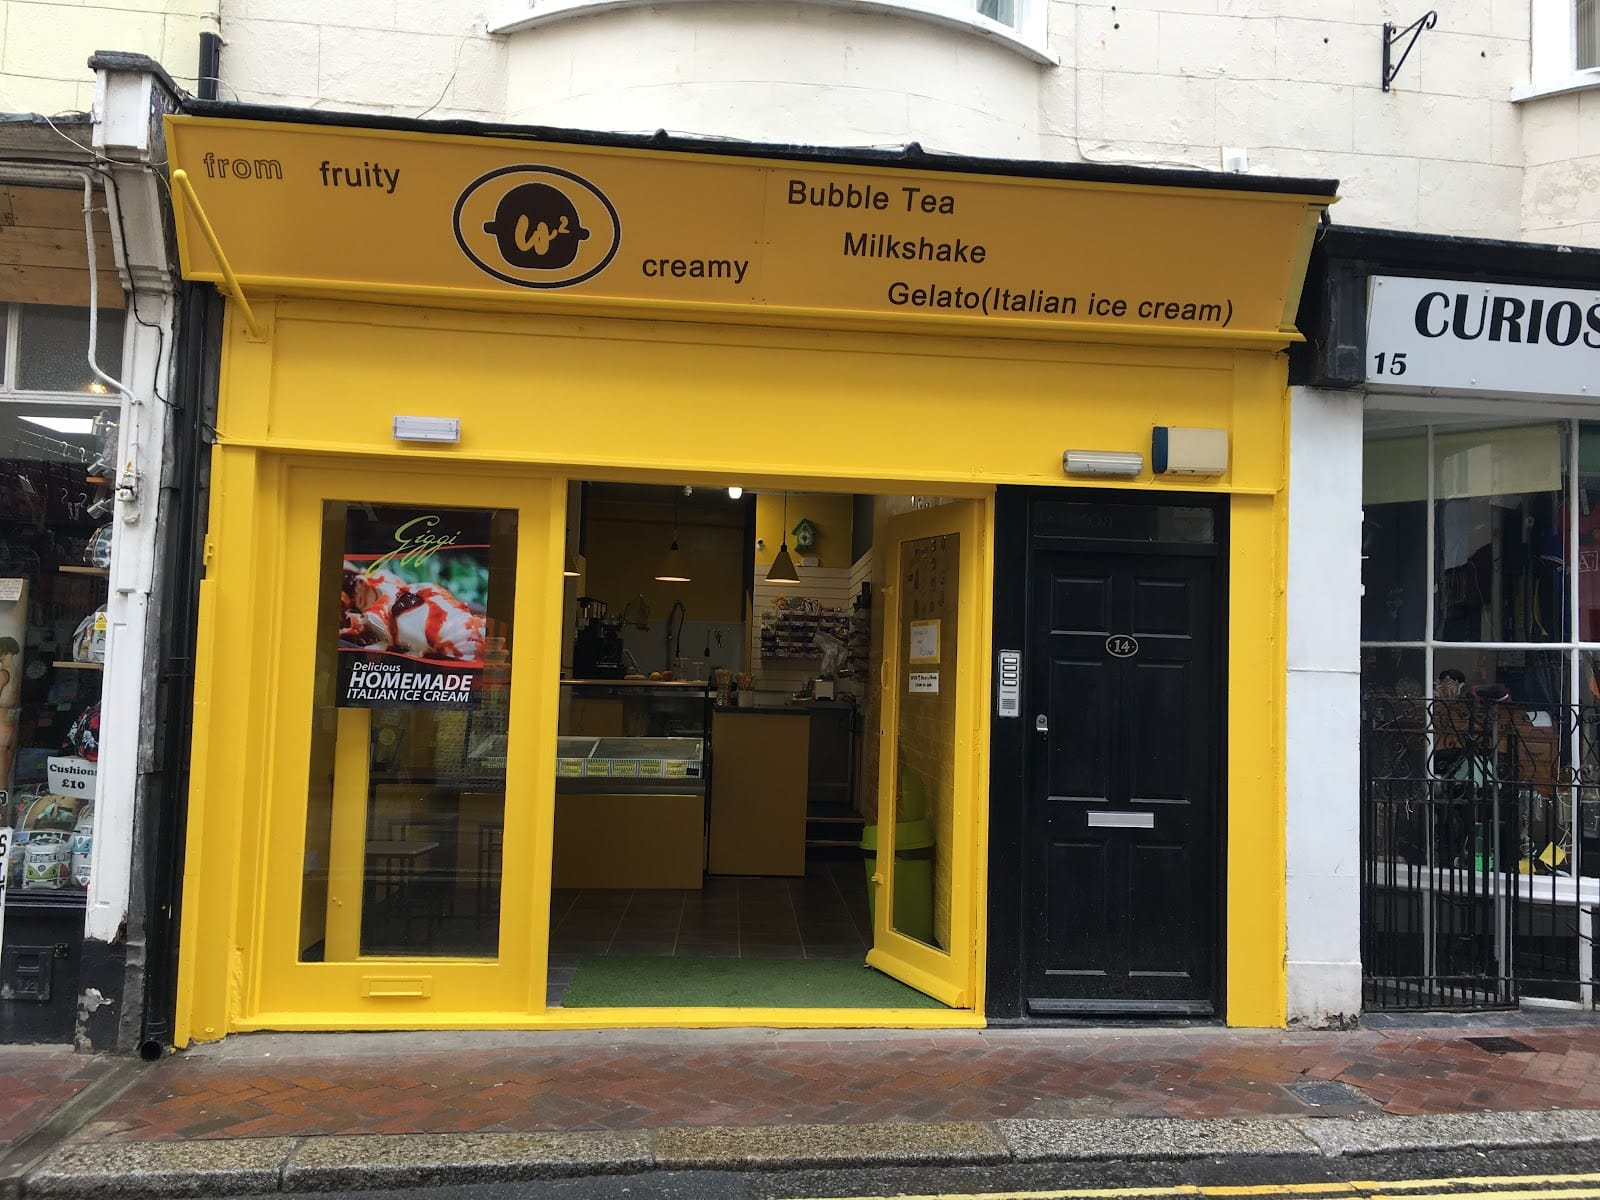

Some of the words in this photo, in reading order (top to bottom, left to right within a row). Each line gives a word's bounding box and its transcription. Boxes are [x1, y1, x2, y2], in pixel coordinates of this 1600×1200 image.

[203, 152, 283, 180] from
[319, 160, 401, 195] fruity
[788, 179, 890, 211] Bubble
[902, 187, 956, 215] Tea
[843, 231, 987, 264] Milkshake
[642, 258, 750, 285] creamy
[1088, 293, 1128, 317] ice
[1137, 299, 1234, 328] cream)
[1374, 352, 1407, 375] 15
[1114, 639, 1130, 653] 14
[352, 661, 401, 672] Delicious
[349, 671, 473, 691] HOMEMADE
[346, 688, 398, 701] ITALIAN
[399, 689, 421, 701] ICE
[423, 690, 470, 703] CREAM
[61, 778, 86, 790] £10
